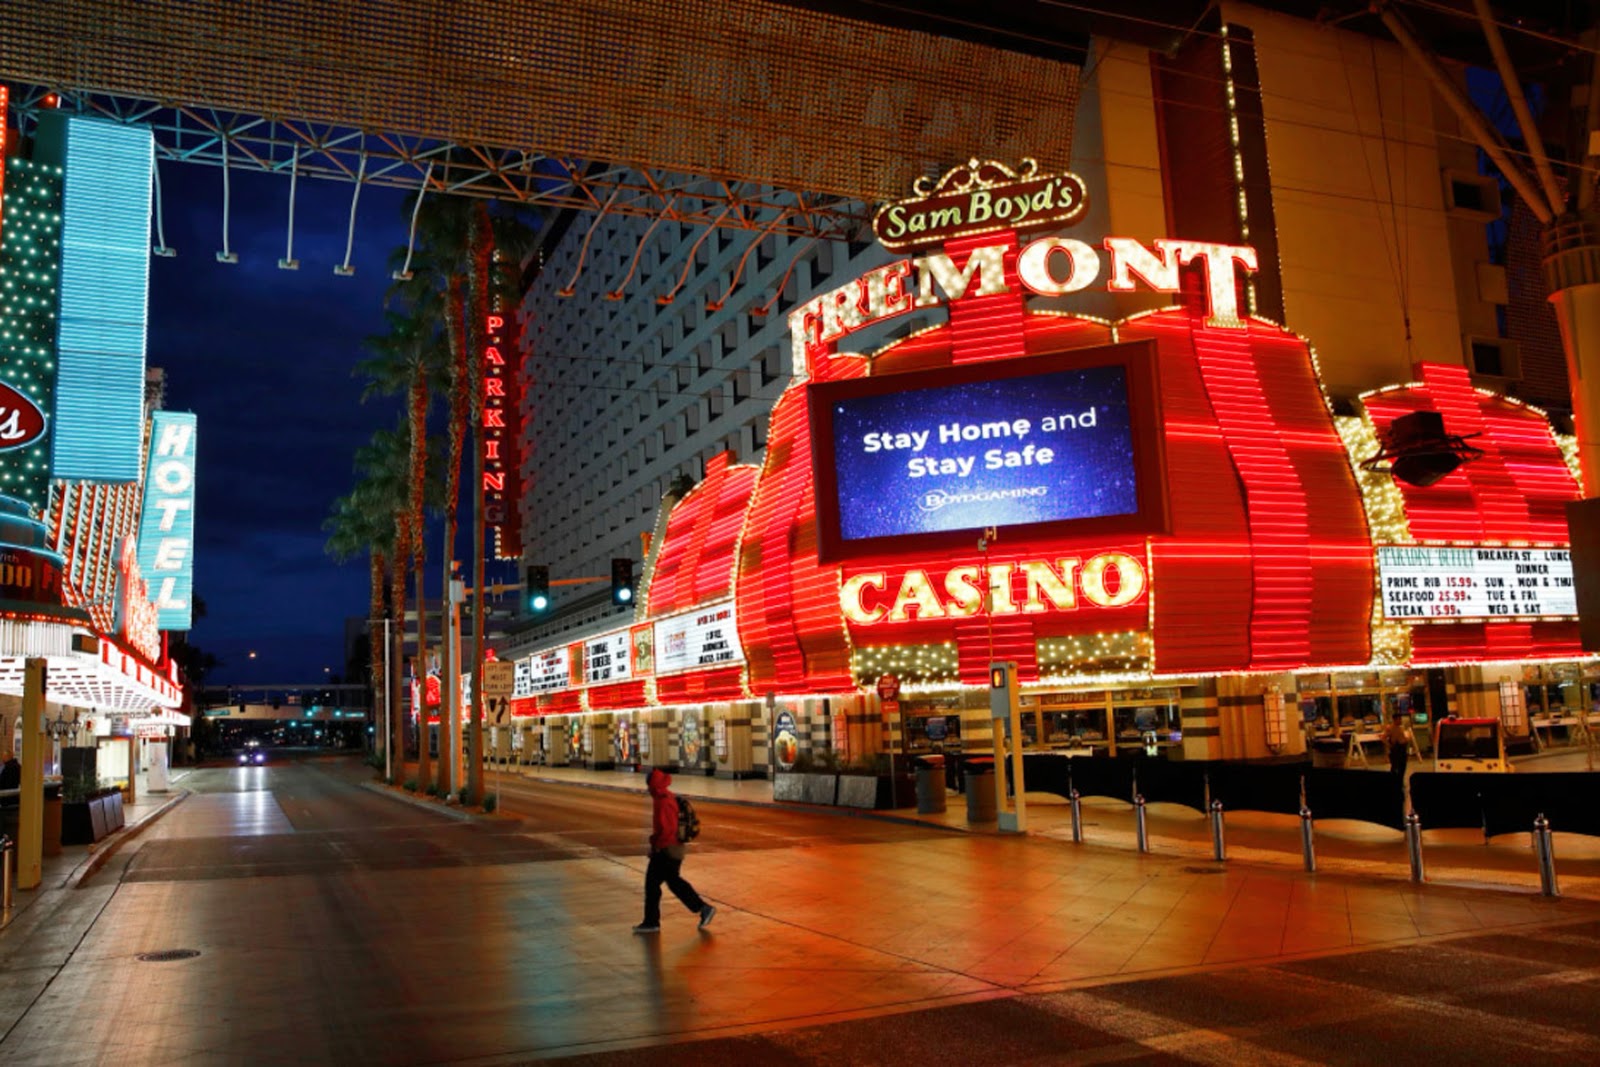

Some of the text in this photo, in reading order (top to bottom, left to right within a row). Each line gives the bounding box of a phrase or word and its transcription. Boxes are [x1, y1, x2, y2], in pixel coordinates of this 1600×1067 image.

[886, 178, 1074, 239] Sam Boyd's
[786, 236, 1259, 388] FREMONT
[484, 316, 506, 524] PARKING
[862, 406, 1097, 453] Stay Home and
[907, 444, 1054, 479] Stay Safe
[154, 423, 193, 610] HOTEL
[1544, 551, 1572, 561] LUNC
[1515, 564, 1549, 574] DINNER
[1387, 577, 1418, 588] PRIME
[1424, 577, 1441, 587] RIB
[1485, 577, 1504, 587] SUN
[1518, 577, 1538, 587] MON
[1543, 577, 1549, 587] &
[1554, 577, 1574, 587] THU
[838, 551, 1148, 627] CASINO
[1388, 591, 1435, 602] SEAFOOD
[1486, 591, 1538, 601] TUE & FRI
[1390, 605, 1424, 616] STEAK
[1488, 604, 1509, 614] WED
[1513, 604, 1520, 614] &
[1524, 604, 1541, 614] SAT
